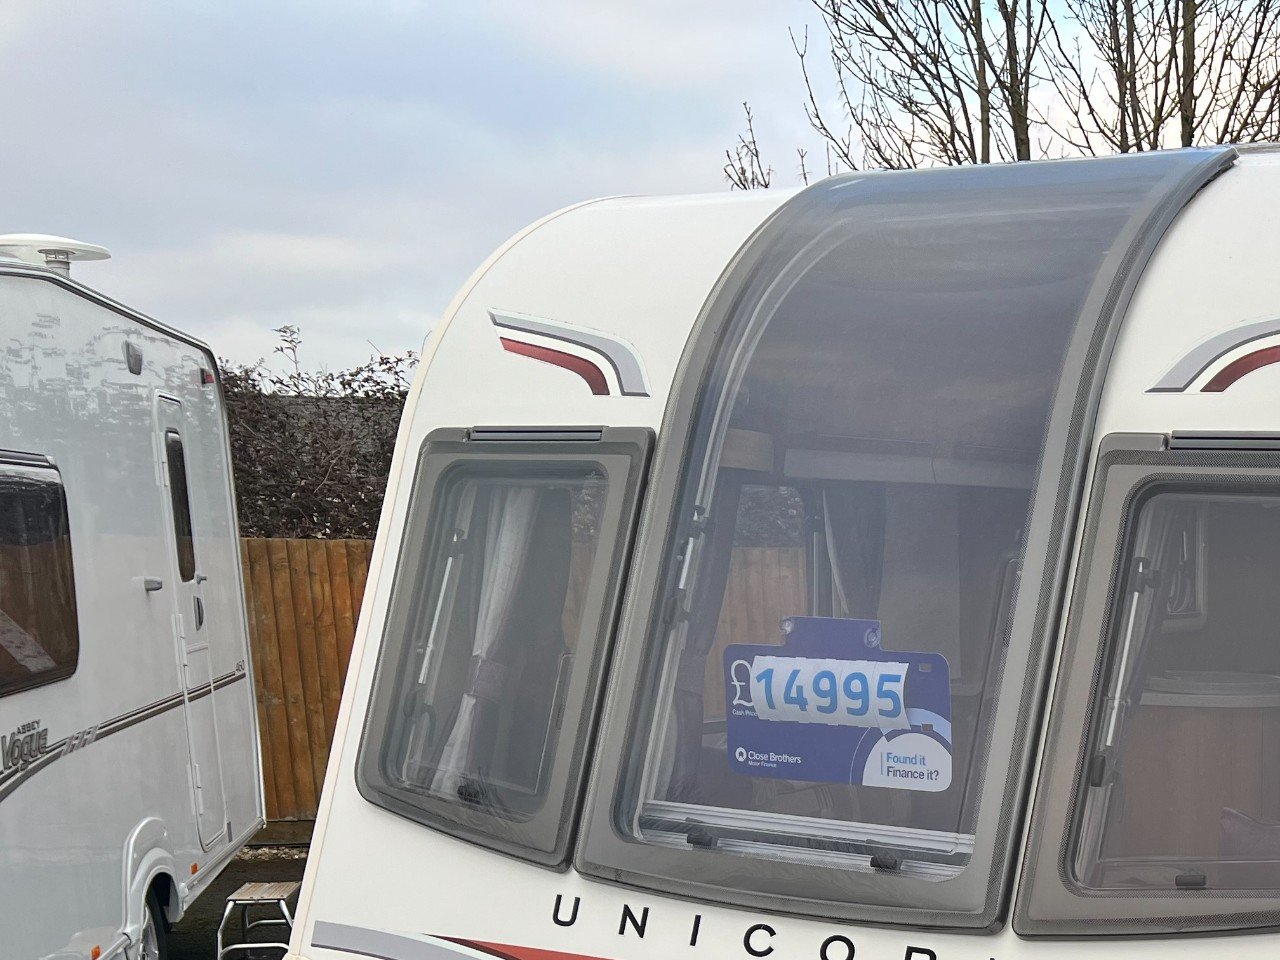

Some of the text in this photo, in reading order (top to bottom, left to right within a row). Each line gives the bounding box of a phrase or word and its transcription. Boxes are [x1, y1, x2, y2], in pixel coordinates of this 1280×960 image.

[748, 750, 802, 764] Close Brothers
[886, 752, 926, 766] Found it
[886, 765, 939, 781] Finance it?
